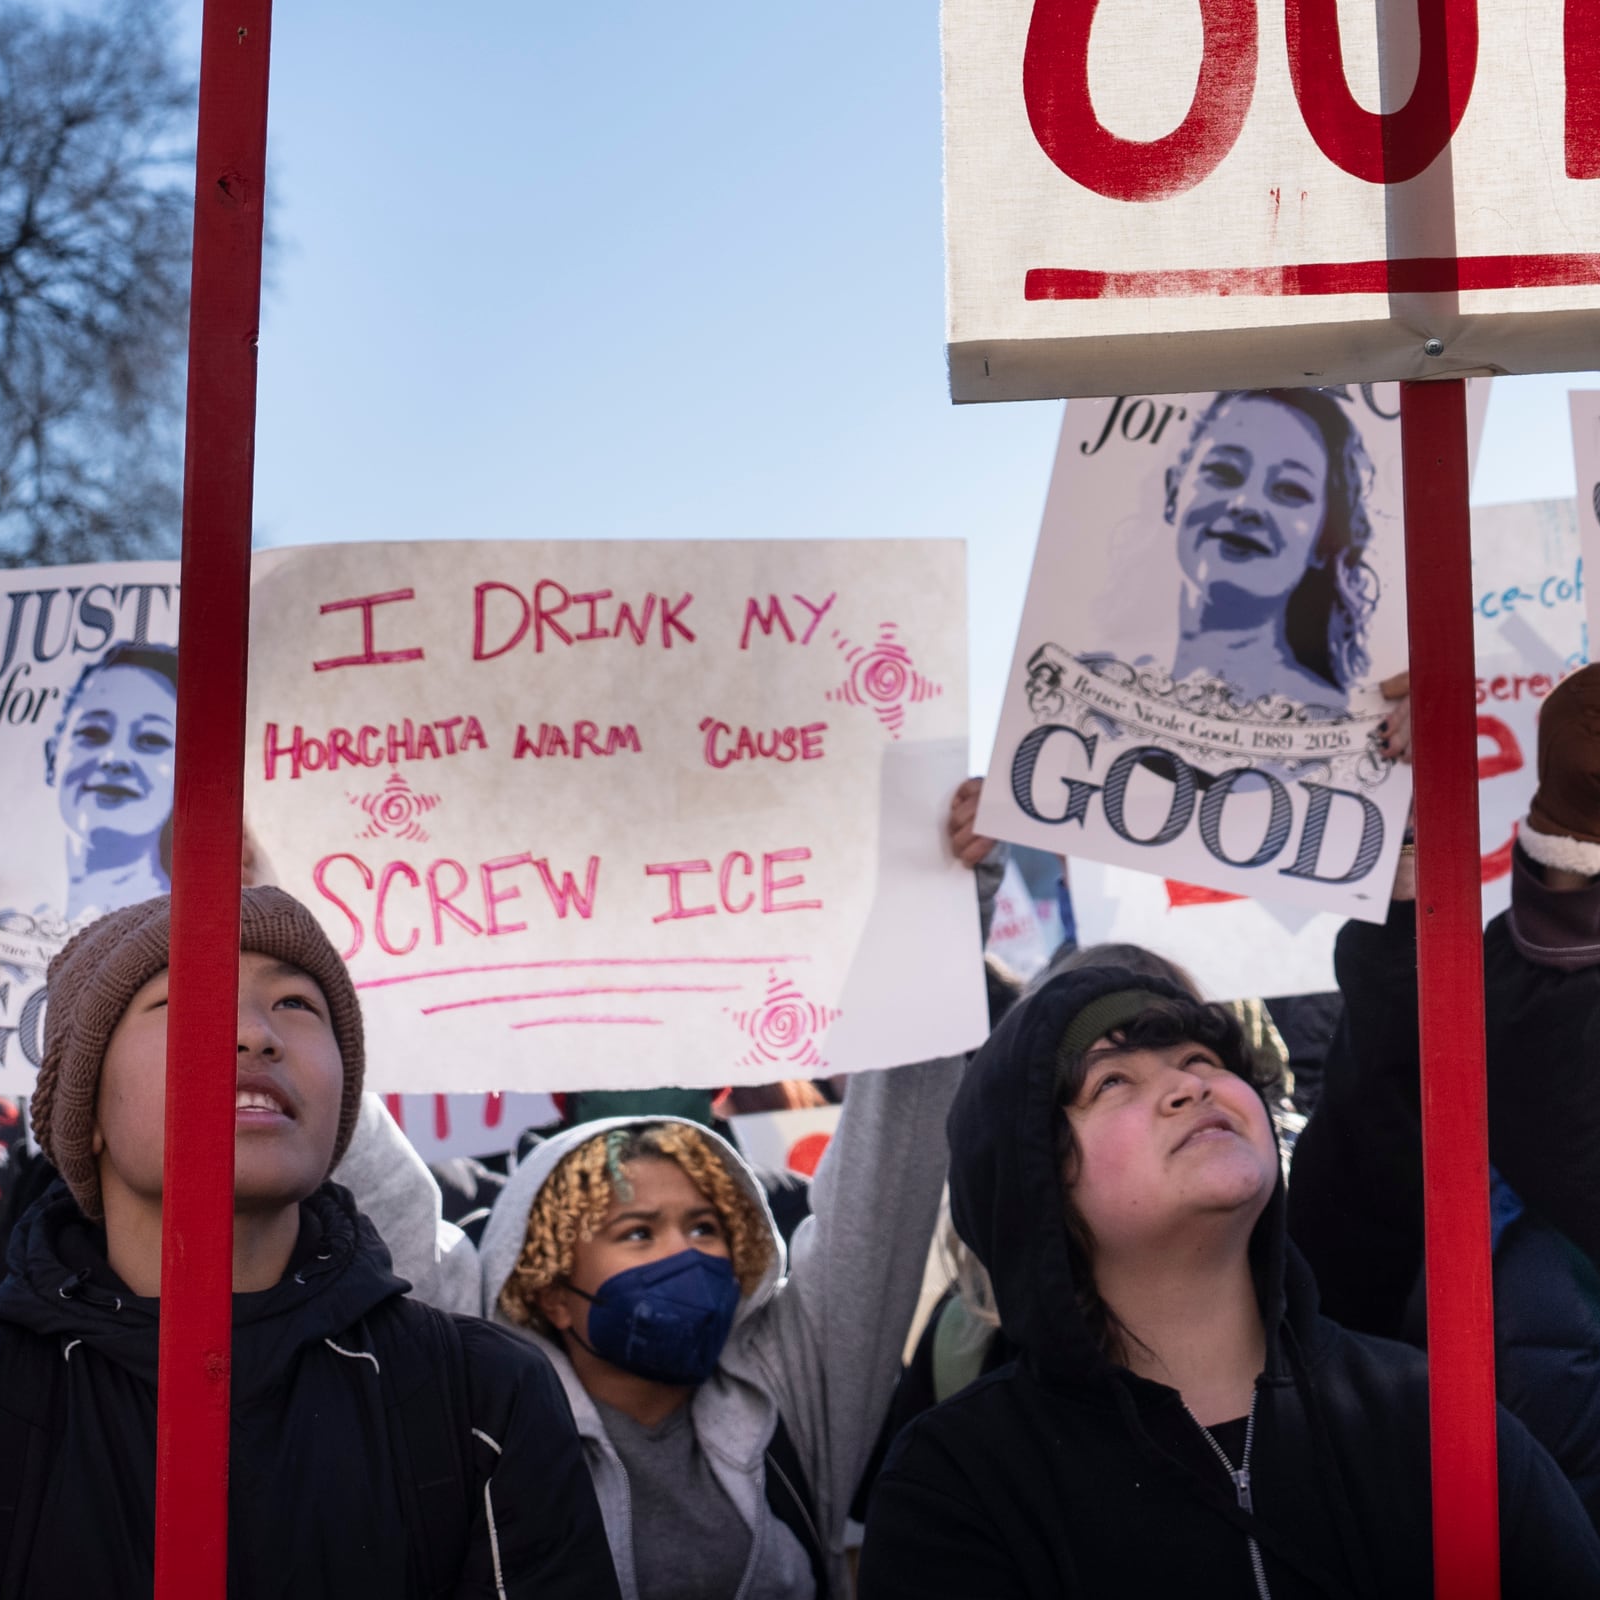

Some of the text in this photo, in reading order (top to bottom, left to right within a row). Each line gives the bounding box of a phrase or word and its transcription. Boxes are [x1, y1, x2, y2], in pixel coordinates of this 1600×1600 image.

[1080, 395, 1186, 456] for
[312, 577, 838, 673] I DRINK MY
[263, 714, 489, 780] HORCHATA
[512, 719, 644, 761] WARM
[1012, 724, 1385, 885] GOOD
[311, 846, 824, 961] SCREW ICE
